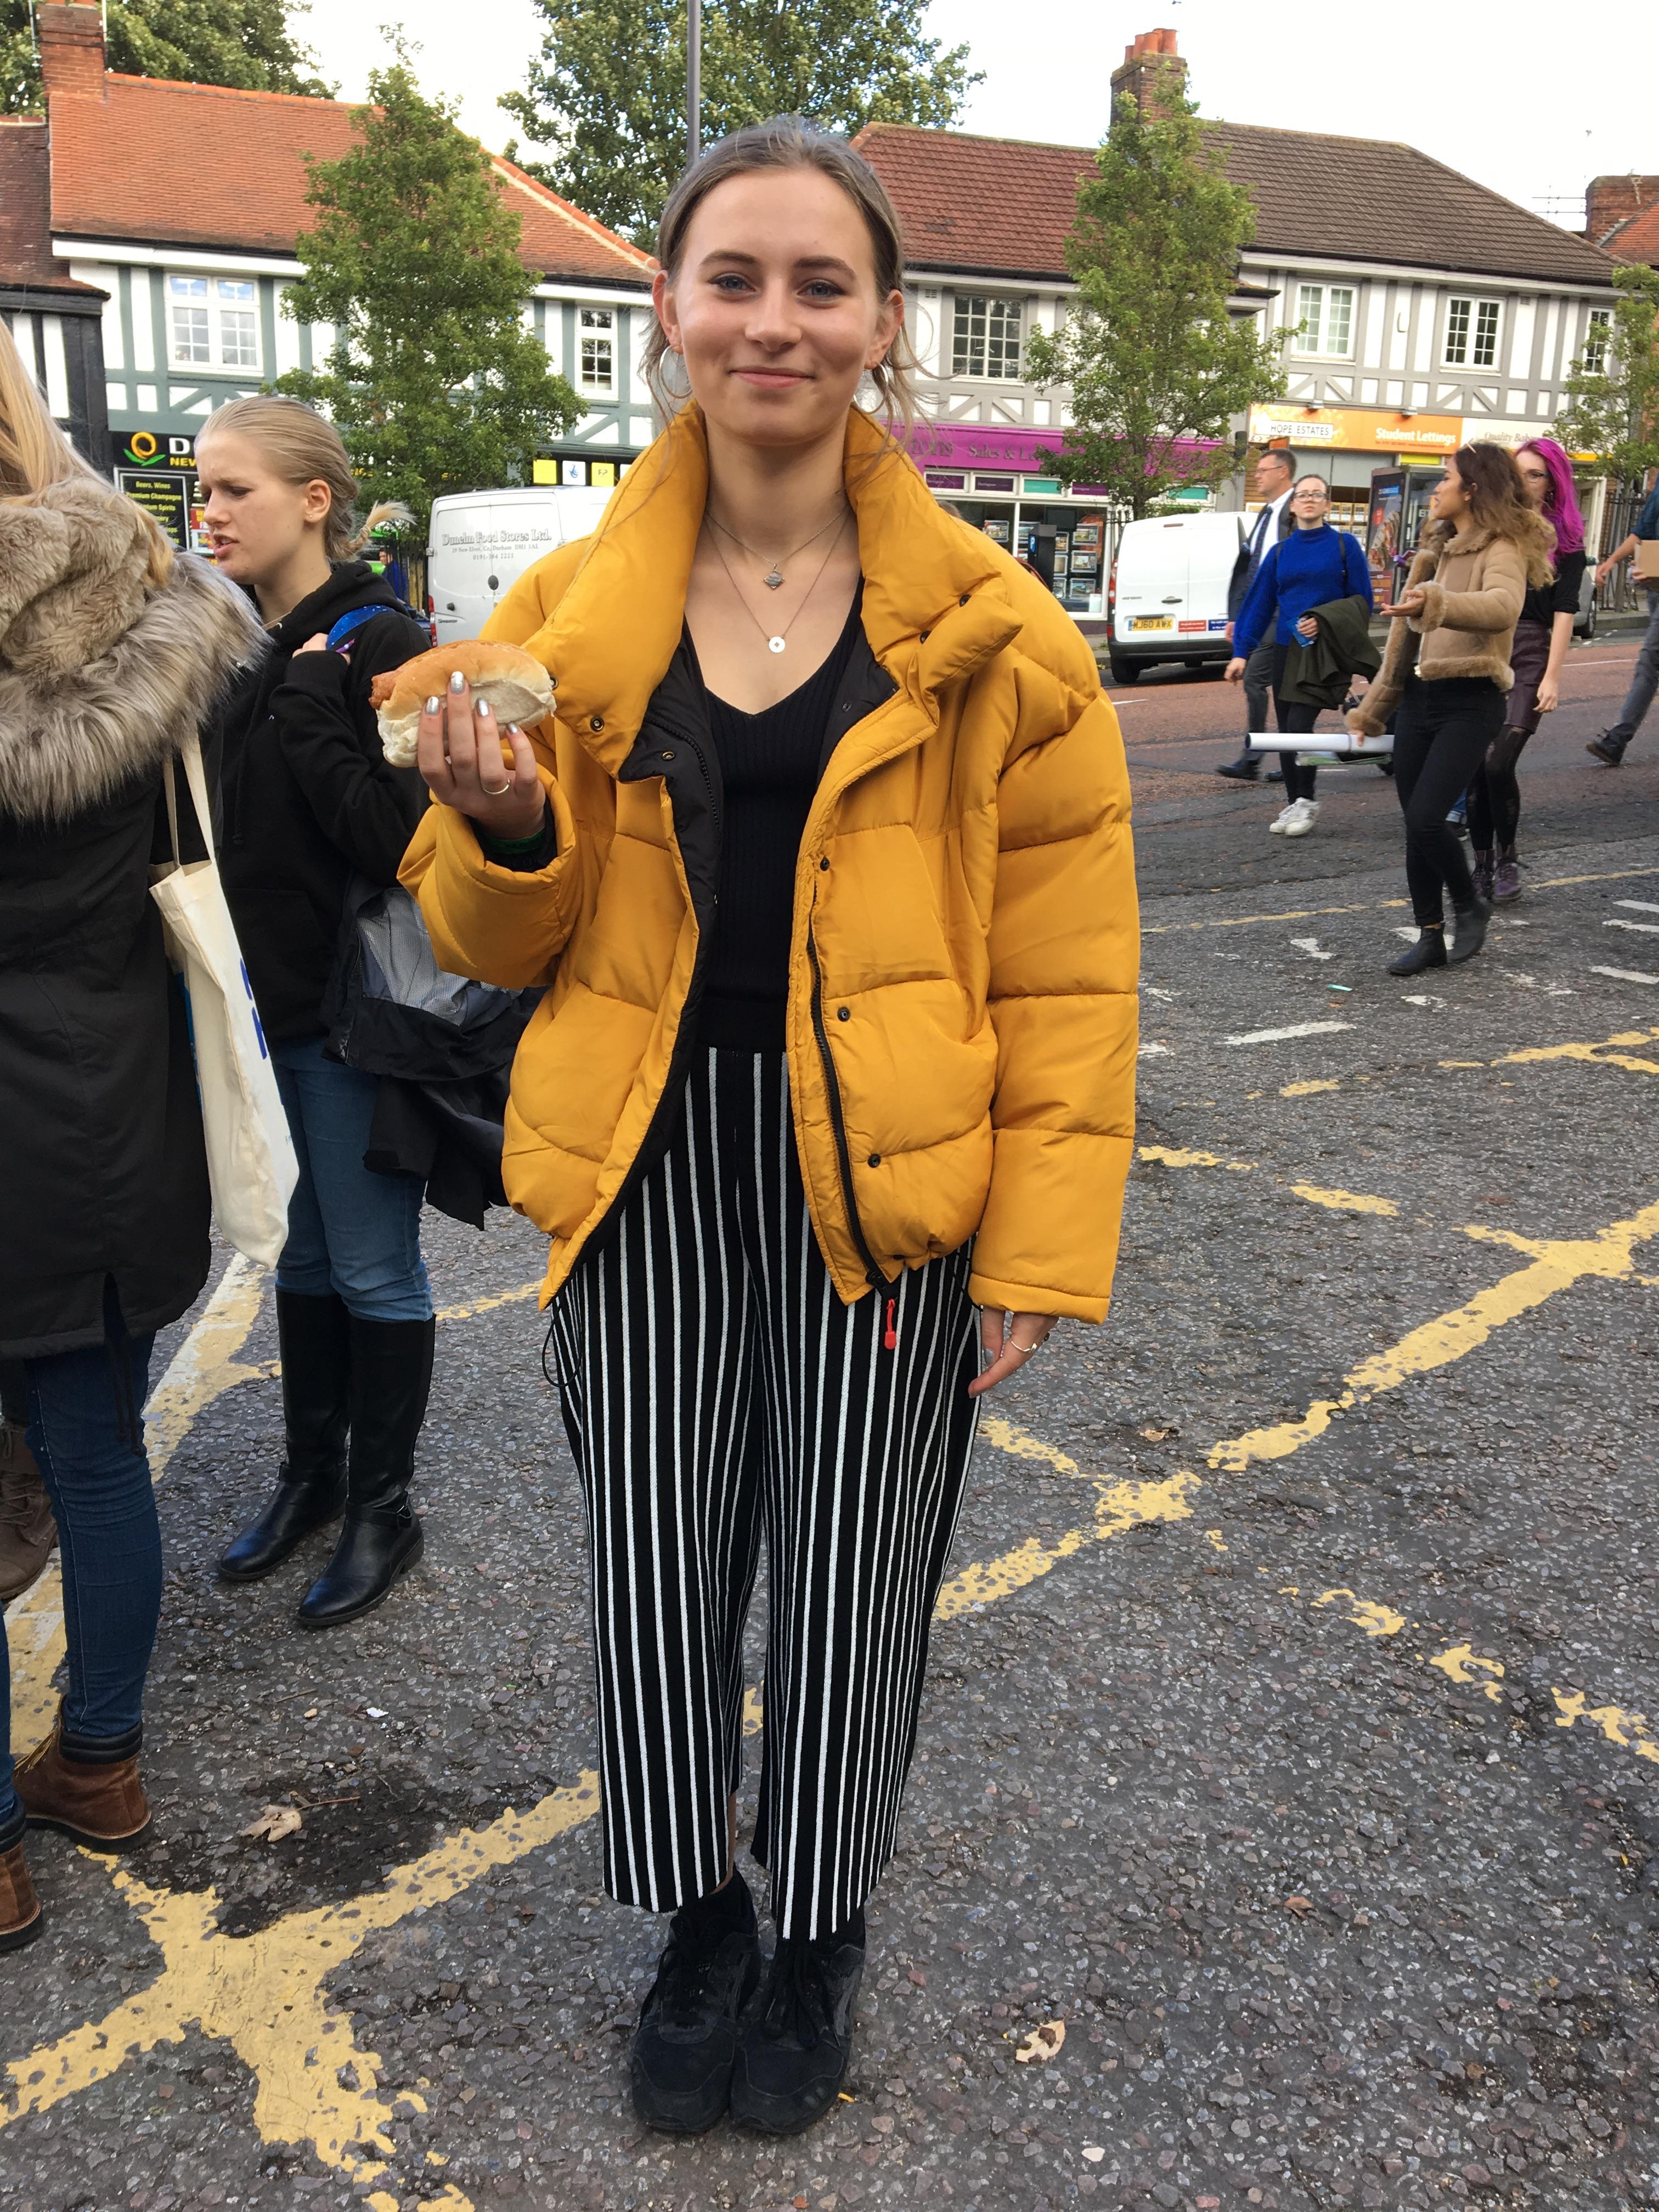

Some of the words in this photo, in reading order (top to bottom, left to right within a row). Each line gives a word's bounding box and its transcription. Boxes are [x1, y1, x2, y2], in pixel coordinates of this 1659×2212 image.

[1271, 425, 1293, 434] HOPE
[1296, 426, 1329, 436] ESTATES
[1376, 427, 1416, 441] Student
[1417, 430, 1456, 446] Lettings
[969, 443, 1001, 459] Sales
[1005, 445, 1015, 460] &
[442, 533, 475, 546] Dunelm
[475, 530, 499, 544] Food
[500, 530, 530, 543] Stores
[531, 528, 552, 541] Ltd.
